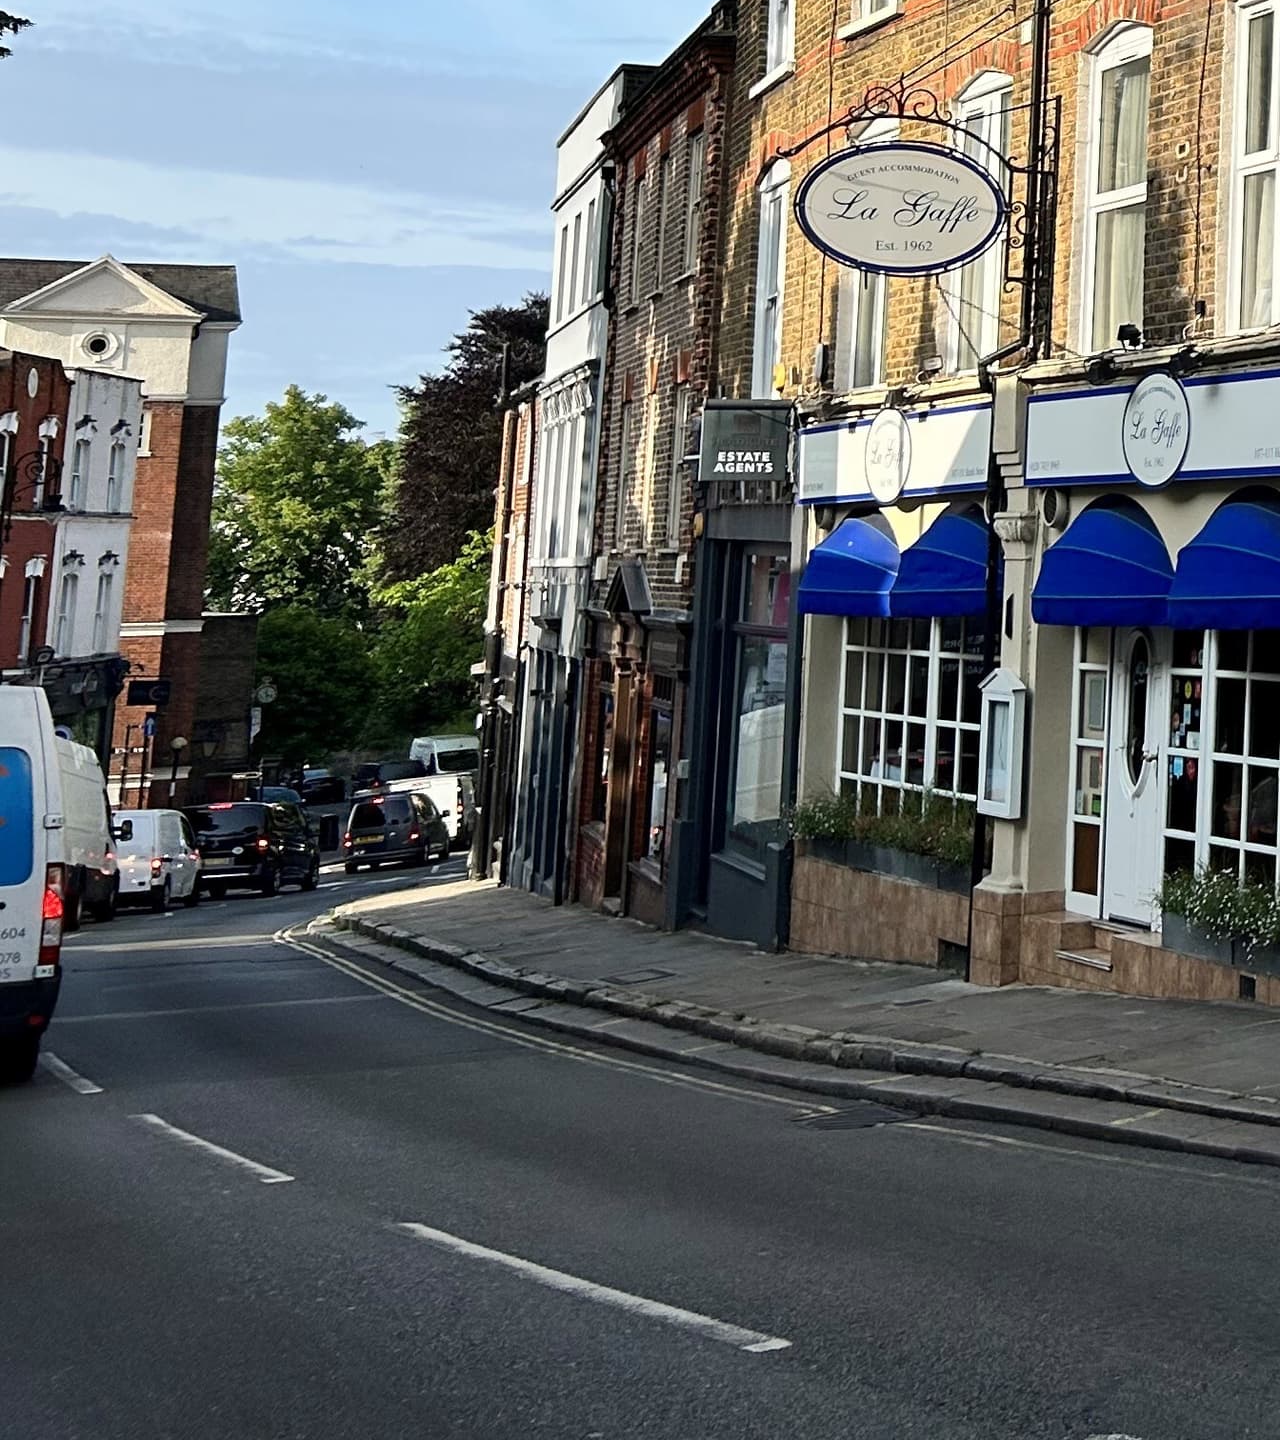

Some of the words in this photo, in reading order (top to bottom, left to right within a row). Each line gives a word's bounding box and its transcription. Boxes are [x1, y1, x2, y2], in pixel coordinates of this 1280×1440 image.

[847, 167, 876, 182] GUEST
[878, 164, 961, 184] ACCOMMODATION
[827, 188, 879, 221] La
[893, 189, 980, 233] Gaffe
[876, 240, 897, 251] Est.
[903, 240, 934, 251] 1962
[1151, 408, 1181, 448] Gaffe
[717, 451, 771, 462] ESTATE
[713, 462, 774, 473] AGENTS
